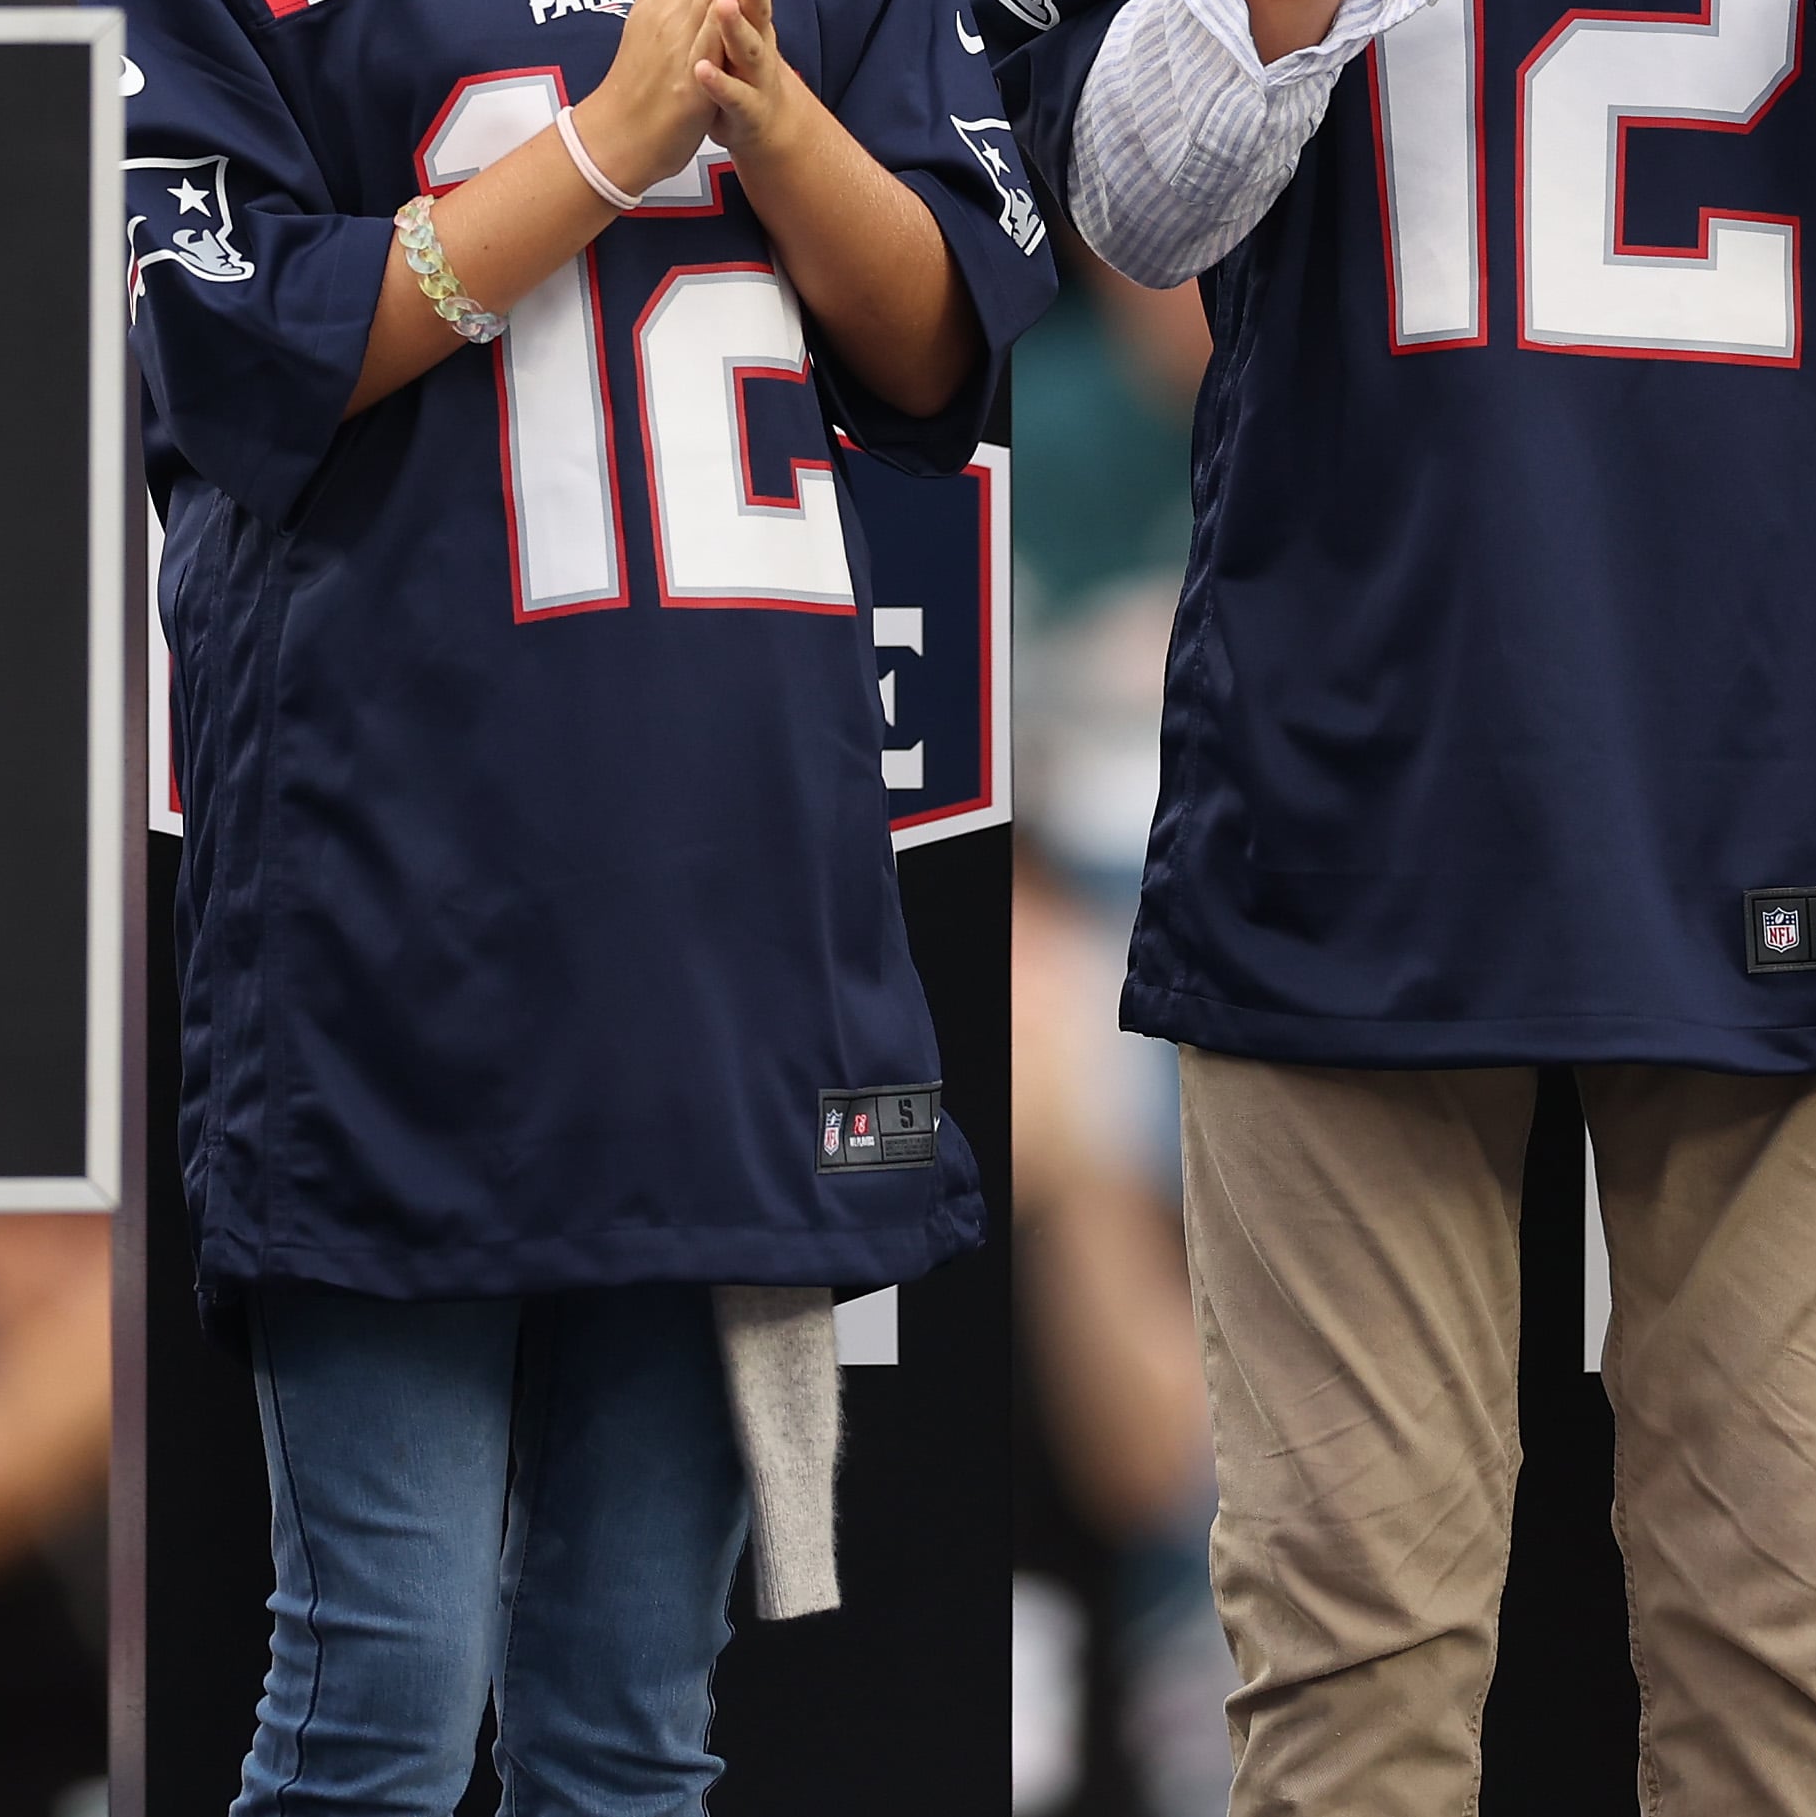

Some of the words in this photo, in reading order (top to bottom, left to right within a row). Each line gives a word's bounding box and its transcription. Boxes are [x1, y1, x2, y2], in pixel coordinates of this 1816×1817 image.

[414, 65, 857, 624] 12
[1769, 925, 1795, 945] NFL
[897, 1098, 914, 1129] S
